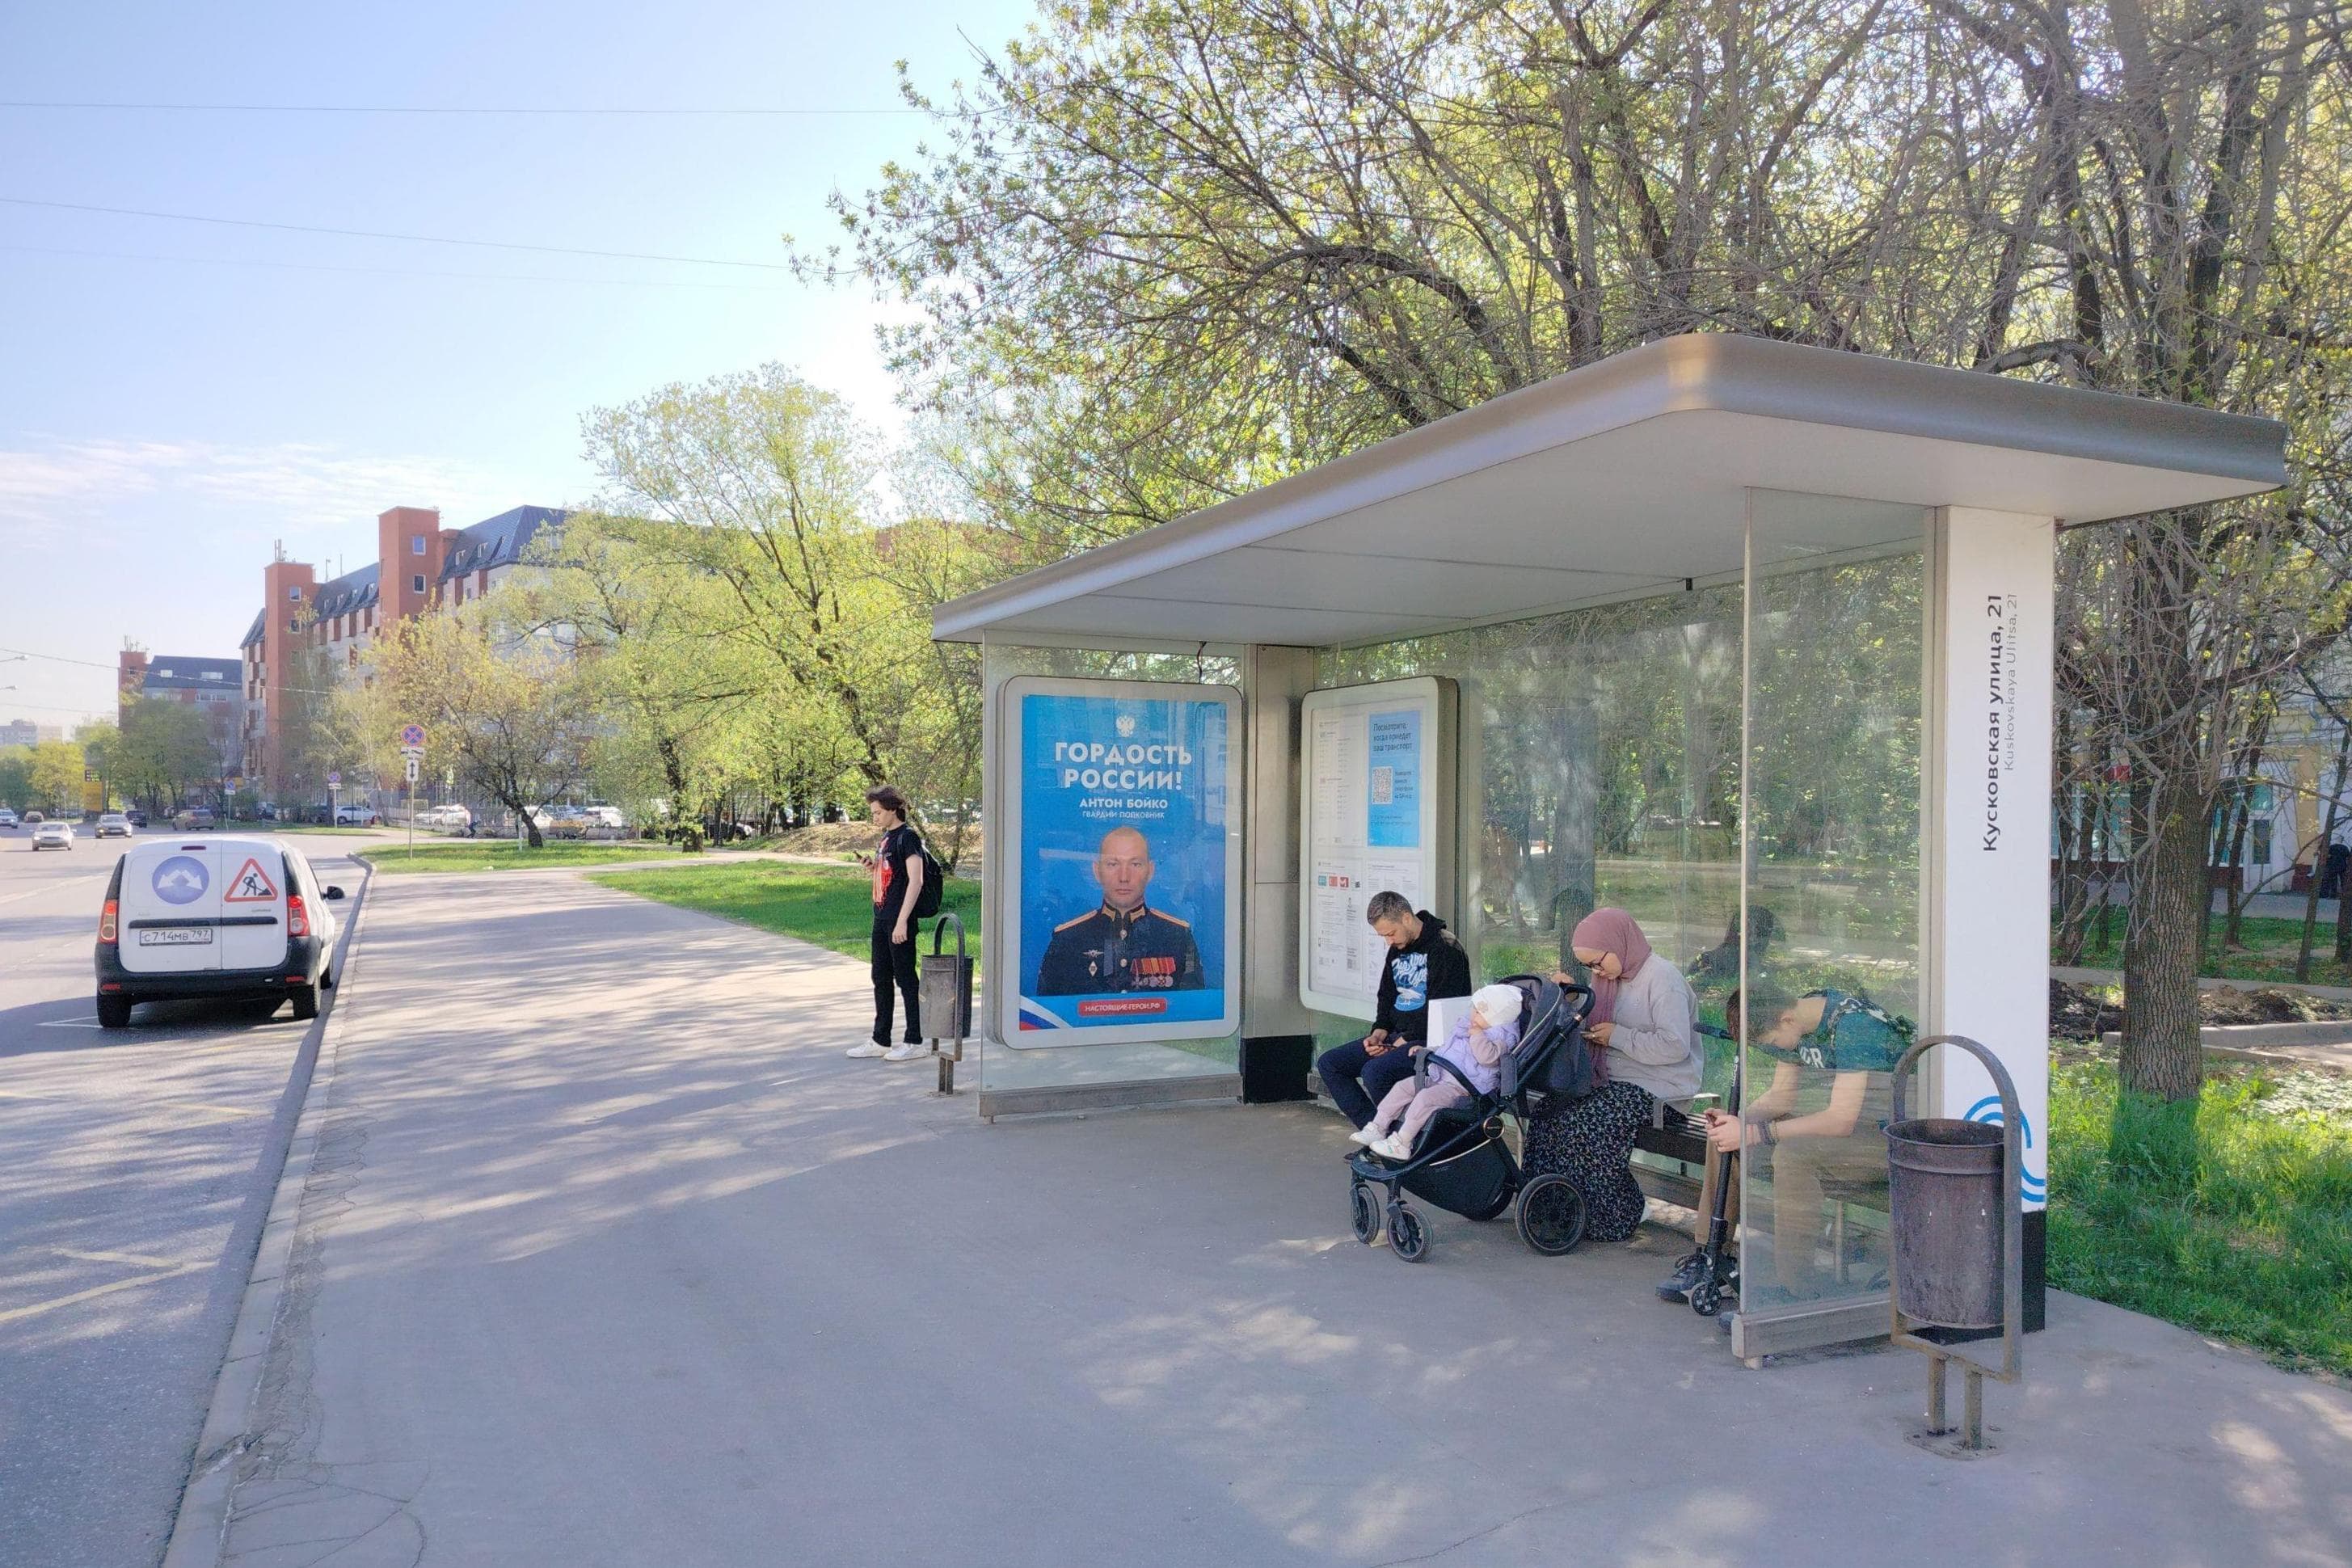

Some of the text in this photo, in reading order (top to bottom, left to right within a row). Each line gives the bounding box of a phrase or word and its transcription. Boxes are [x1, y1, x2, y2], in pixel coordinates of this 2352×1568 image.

[2004, 594, 2017, 770] Kuskovskaya Ulitsa, 21
[1983, 595, 2004, 851] Кусковская улица, 21
[1056, 742, 1192, 765] ГОРДОСТЬ
[1064, 769, 1182, 790] РОССИИ!
[1080, 797, 1169, 809] АНТОН БОЙКО
[1082, 811, 1119, 819] ГВАРДИИ
[1085, 1002, 1161, 1012] НАСТОЯЩИЕ-ГЕРОИ.РФ
